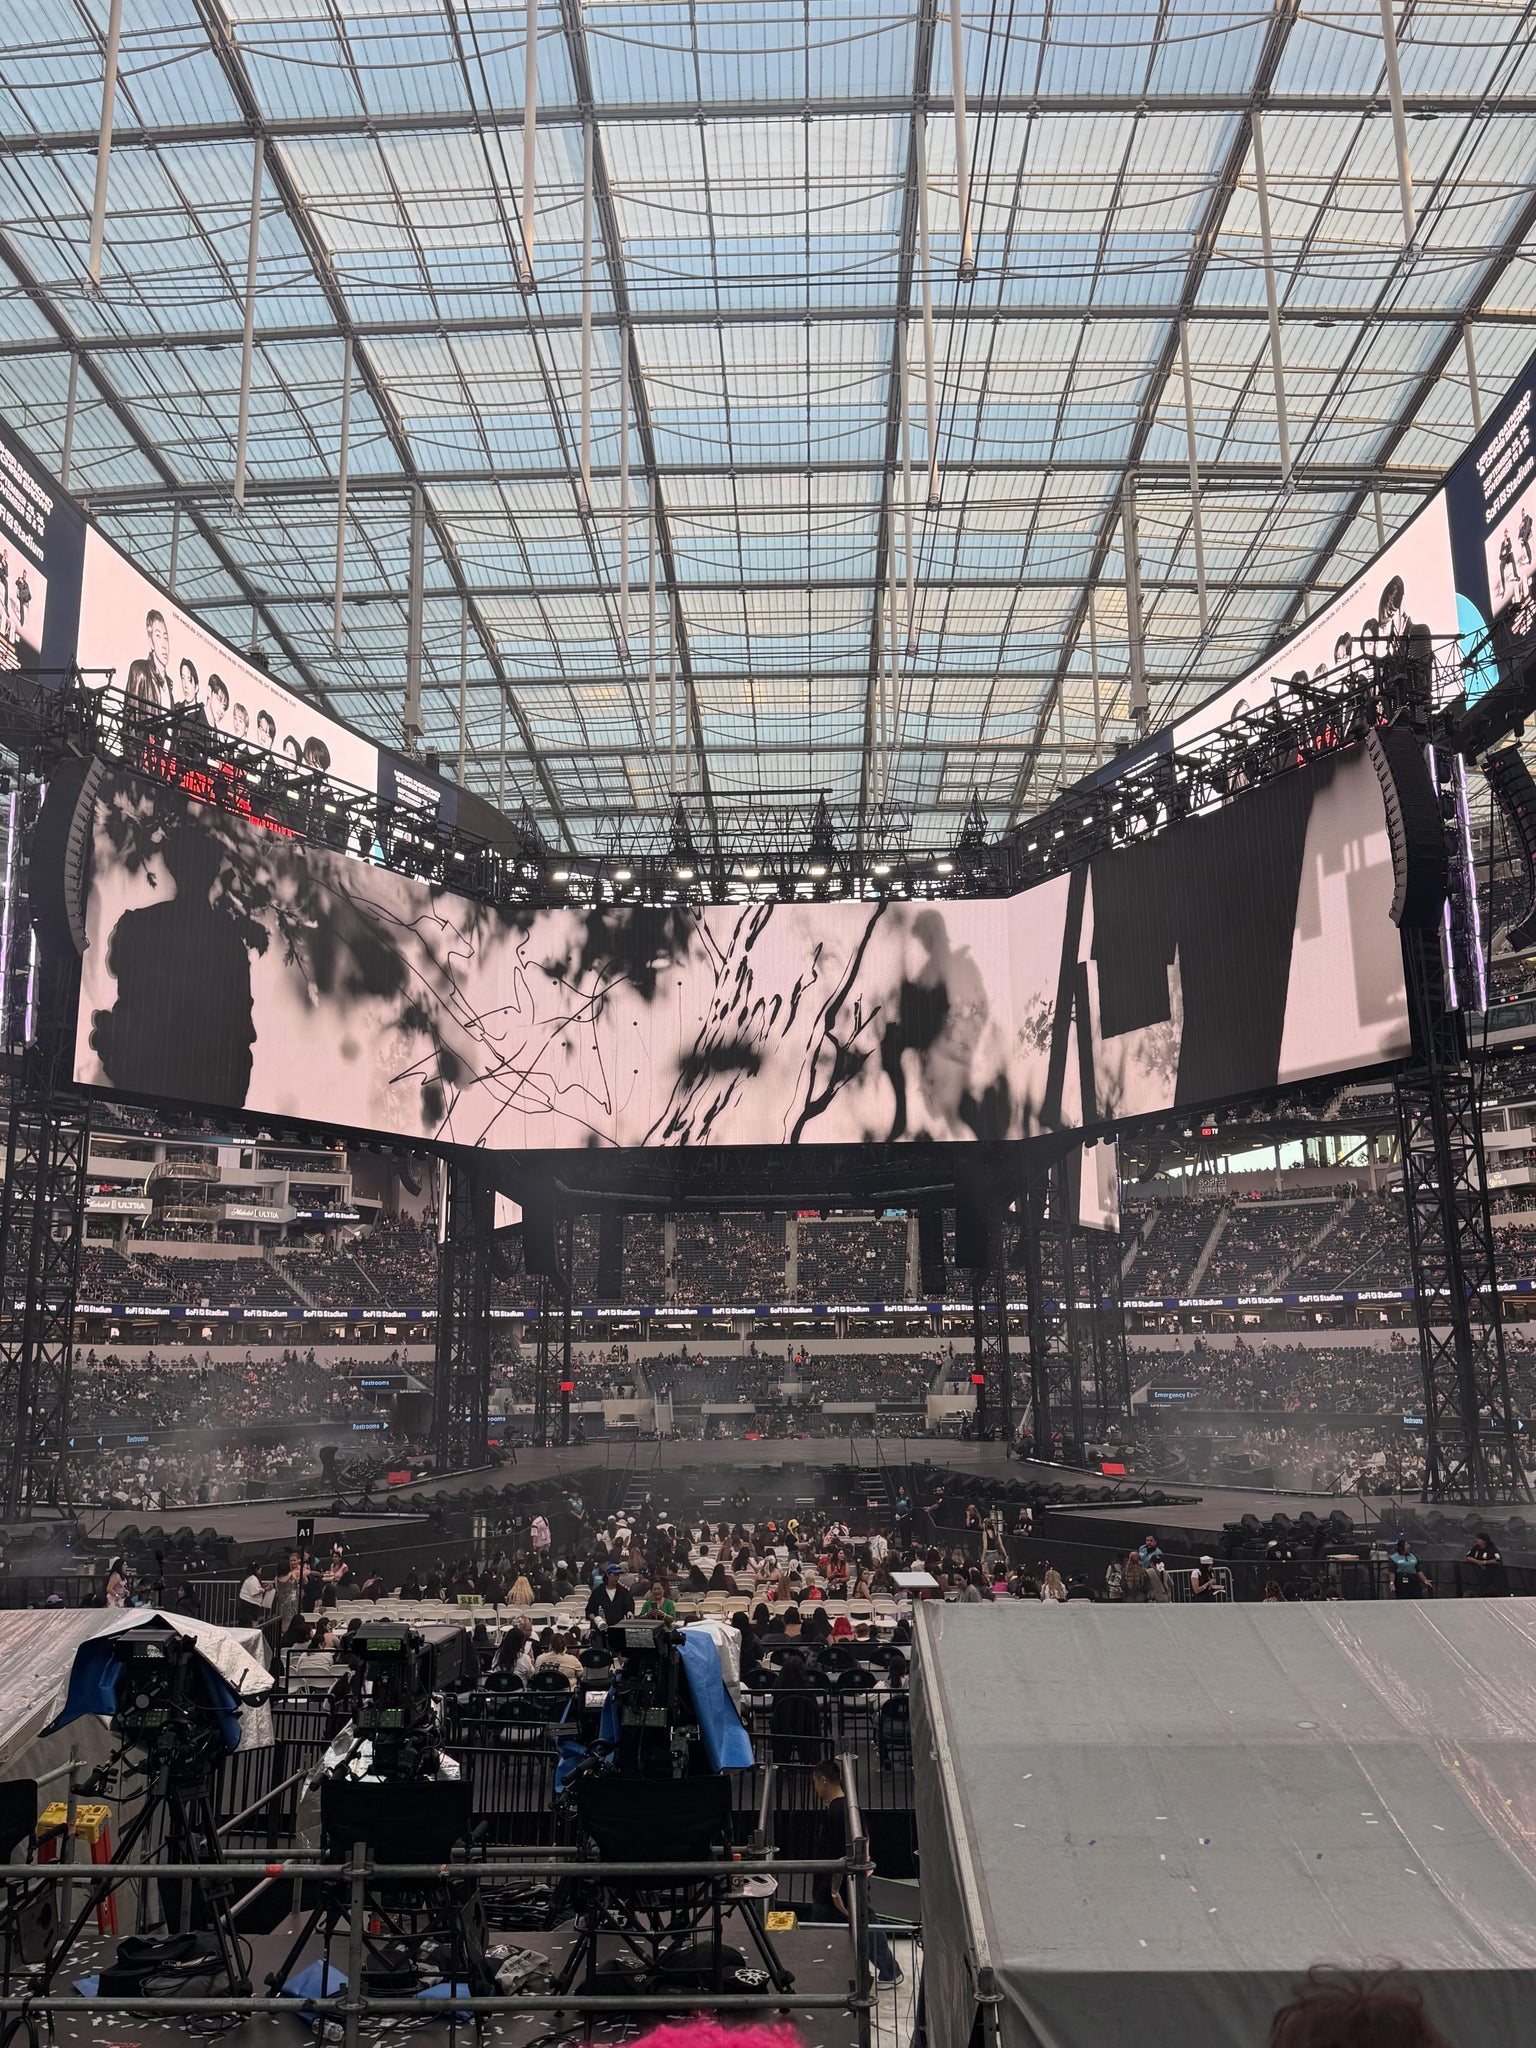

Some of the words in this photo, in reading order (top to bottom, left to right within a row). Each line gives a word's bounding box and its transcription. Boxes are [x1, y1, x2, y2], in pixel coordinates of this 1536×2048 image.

[1498, 389, 1531, 442] RAYMOND
[1505, 400, 1531, 440] BROWN
[17, 462, 53, 509] RAYMOND
[1482, 446, 1512, 490] SEPTEMBER
[1484, 457, 1512, 500] NOVEMBER
[22, 479, 51, 516] BROWN
[1485, 497, 1500, 524] SoFi
[1506, 455, 1535, 499] Stadium
[13, 519, 44, 562] Stadium
[117, 1201, 146, 1209] ULTRA
[258, 1210, 279, 1219] ULTRA
[89, 1305, 112, 1313] Stadium
[145, 1307, 170, 1315] Stadium
[1154, 1391, 1186, 1399] Emergency
[299, 1528, 310, 1537] A1
